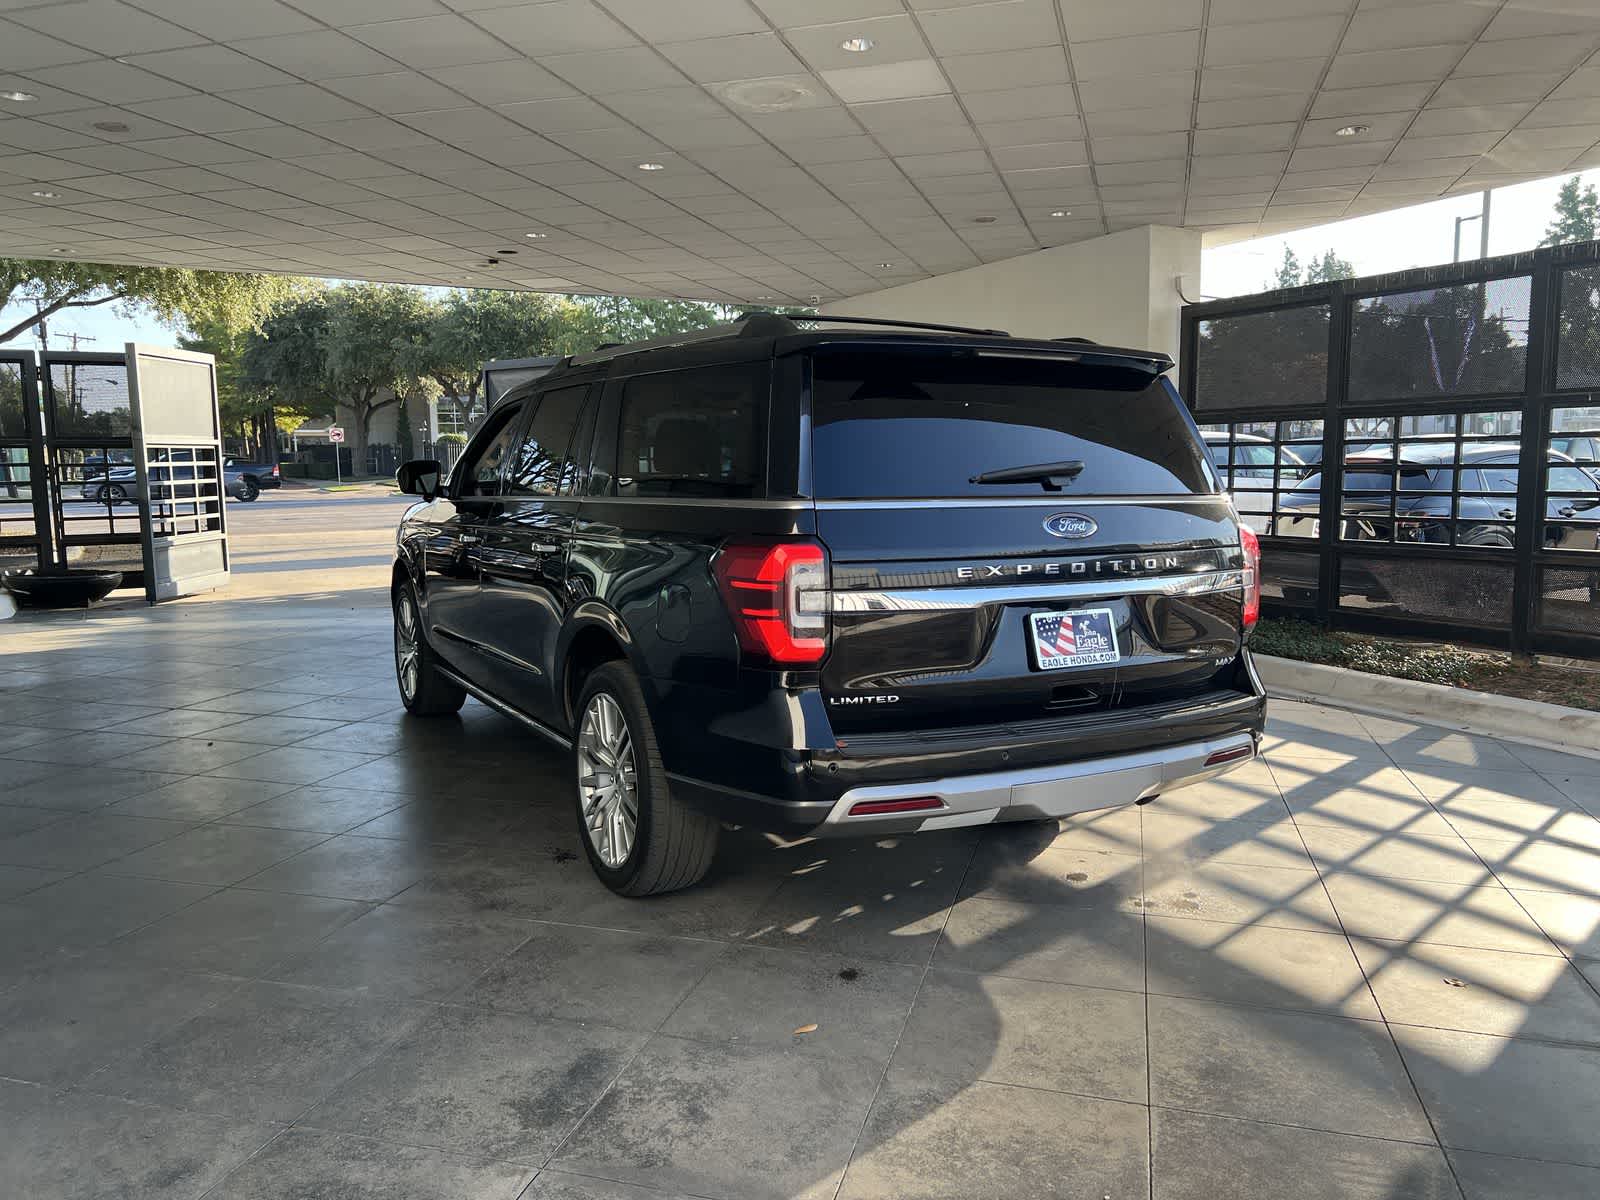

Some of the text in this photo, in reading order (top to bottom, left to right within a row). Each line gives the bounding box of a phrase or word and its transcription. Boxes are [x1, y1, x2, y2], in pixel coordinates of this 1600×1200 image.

[1058, 517, 1087, 532] Ford
[957, 557, 1177, 578] EXPEDITION
[1075, 632, 1108, 649] Eagle
[1042, 658, 1069, 668] EAGLE
[1215, 655, 1236, 666] MAX
[830, 695, 900, 705] LIMITED
